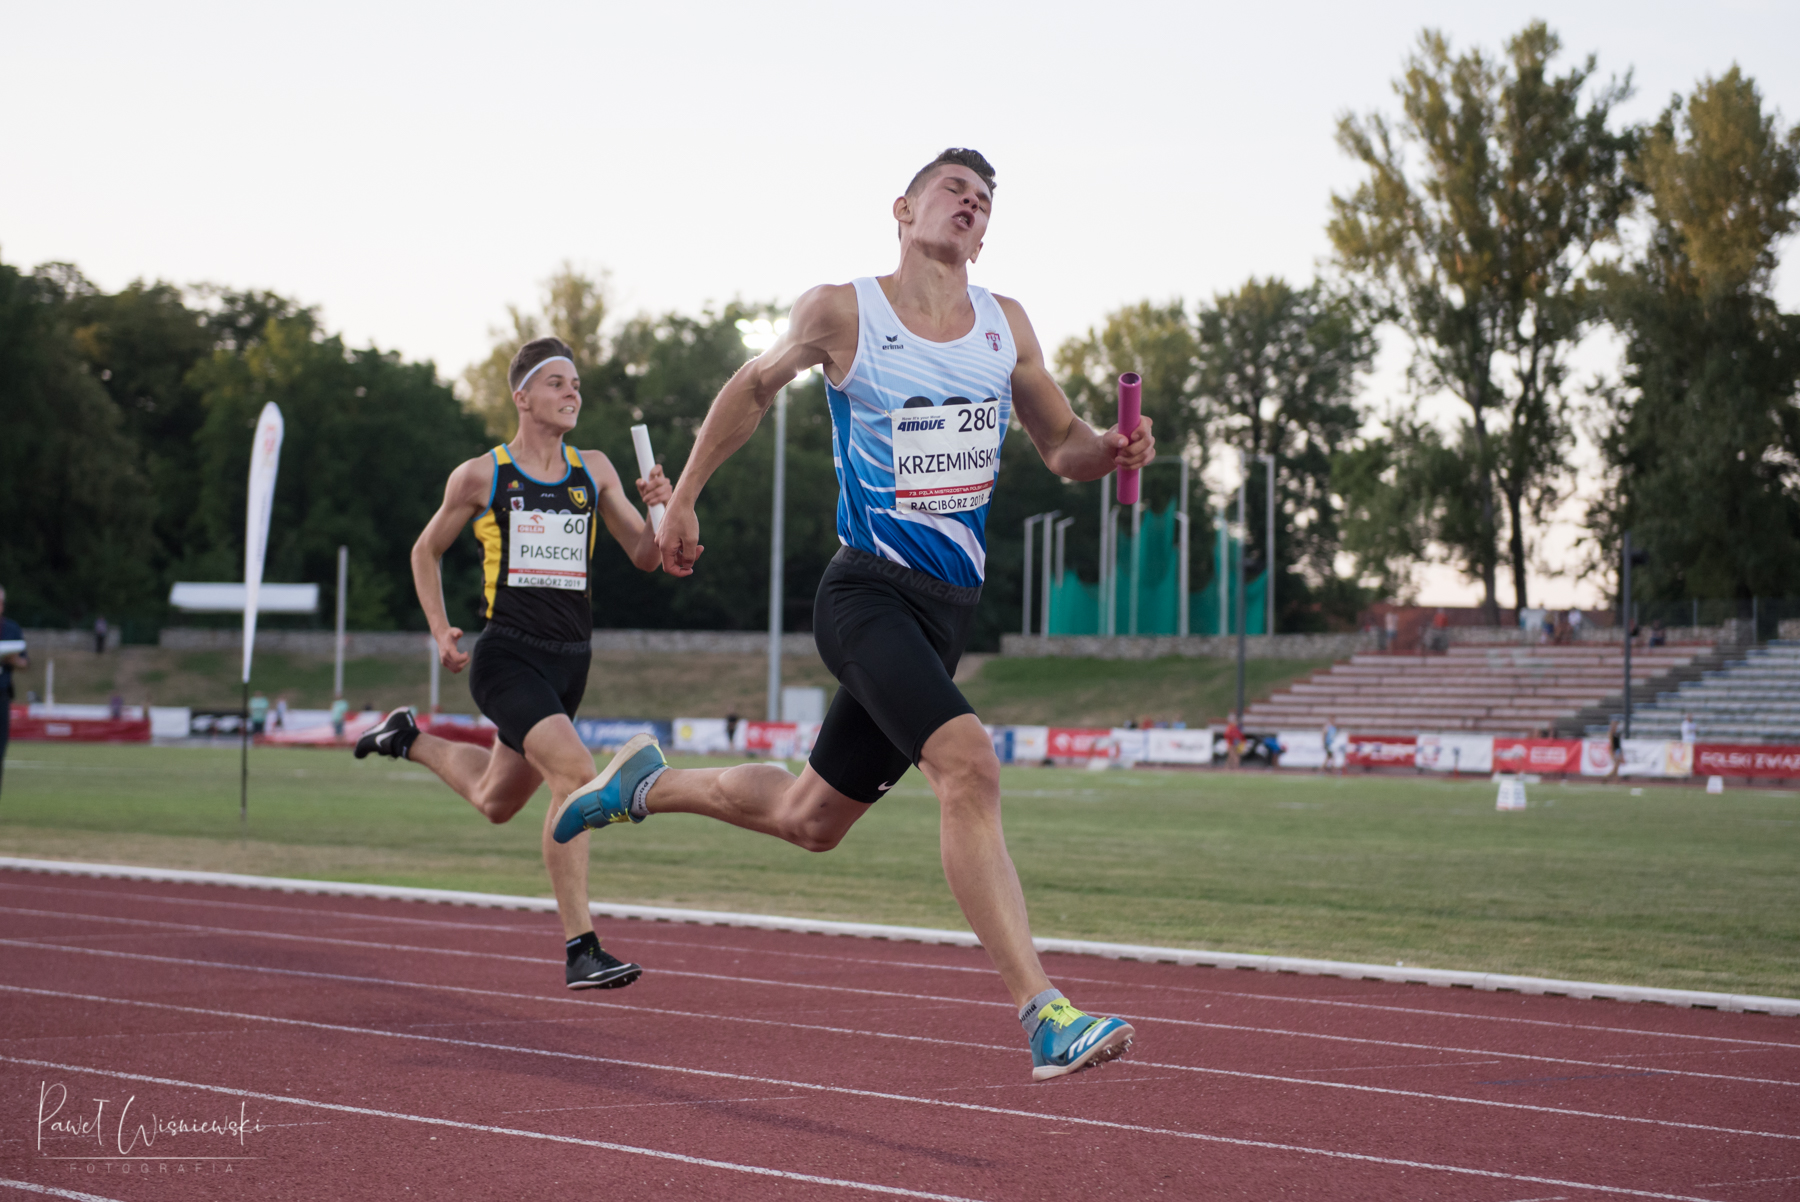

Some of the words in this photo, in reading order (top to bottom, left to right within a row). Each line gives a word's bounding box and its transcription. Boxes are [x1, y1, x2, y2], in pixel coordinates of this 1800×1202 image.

[958, 406, 997, 433] 280
[899, 446, 997, 475] KRZEMIŃSKI
[911, 496, 968, 511] RACIBÓRZ
[969, 493, 985, 507] 2019
[519, 525, 544, 533] ORLEN
[563, 518, 585, 534] 60
[520, 544, 583, 561] PIASECKI
[518, 575, 562, 586] RACIBÓRZ
[564, 579, 581, 587] 2019
[854, 552, 899, 578] PRO
[900, 568, 947, 596] NIKE
